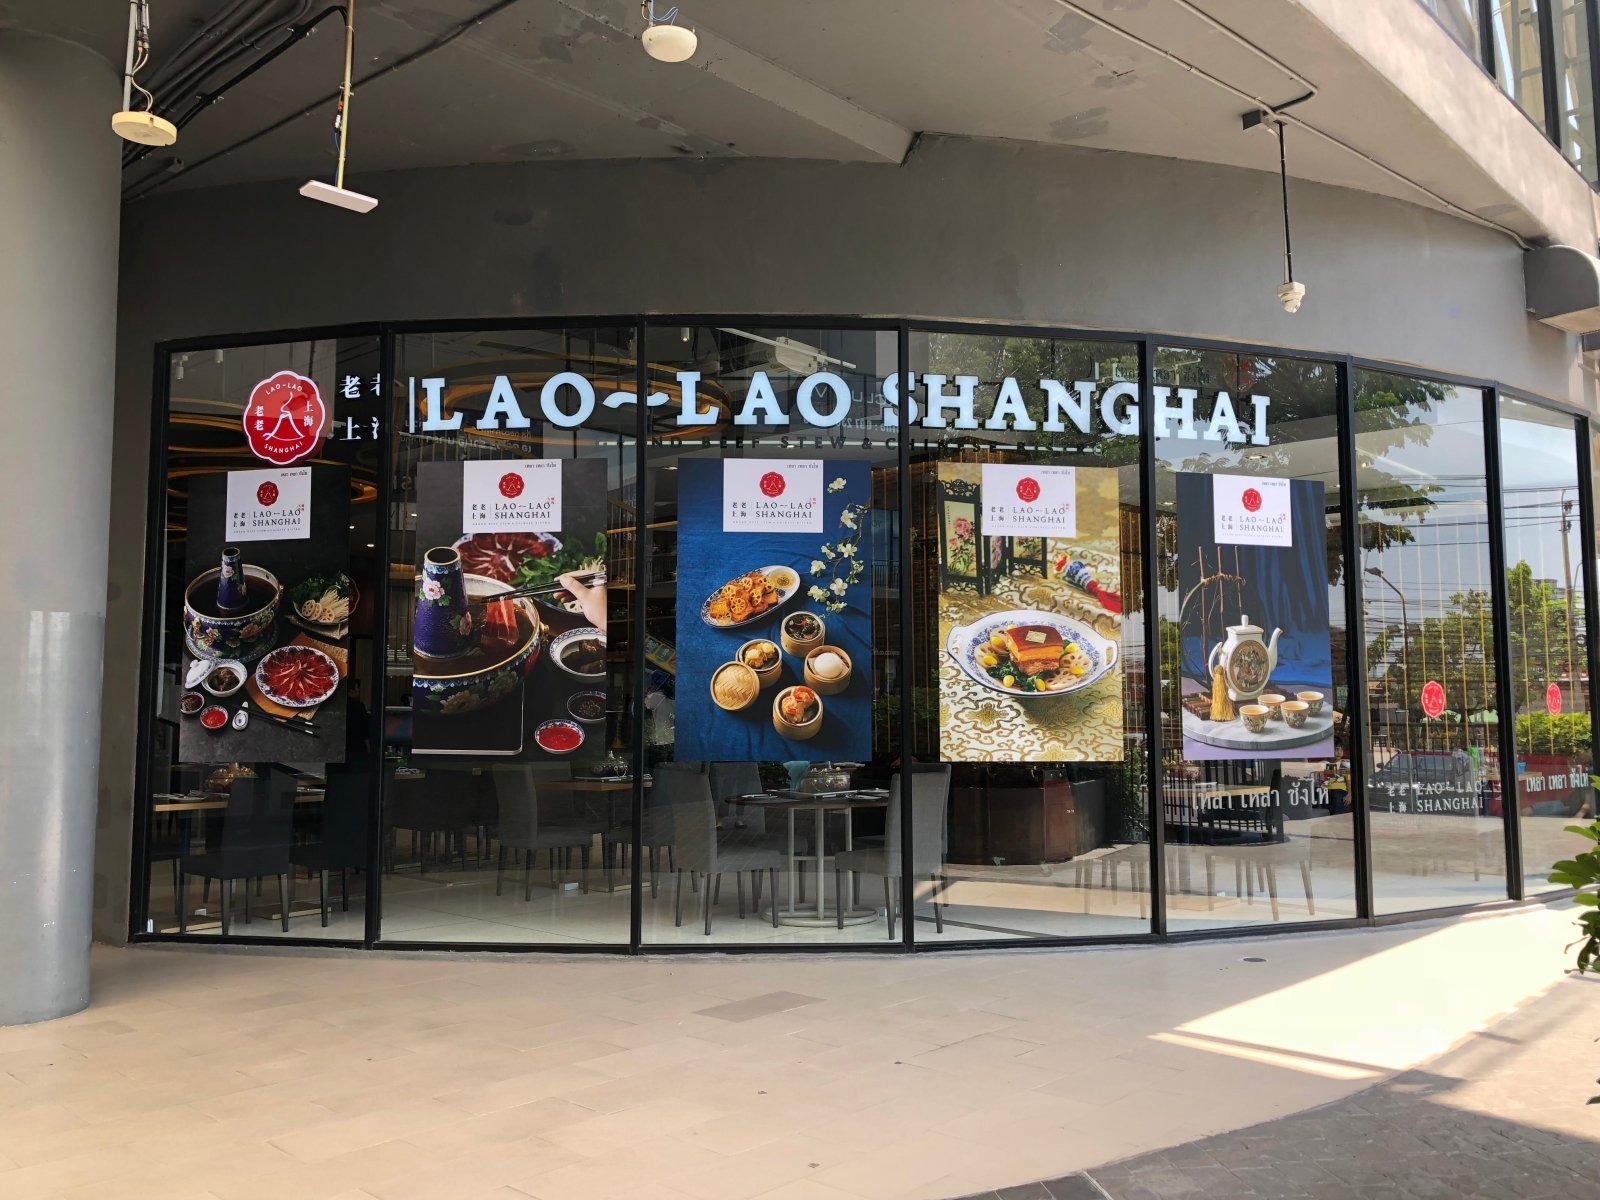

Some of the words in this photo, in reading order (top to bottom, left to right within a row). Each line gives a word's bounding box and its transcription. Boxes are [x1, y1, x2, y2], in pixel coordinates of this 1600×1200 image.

[265, 382, 303, 395] LAO-LAO
[882, 371, 1270, 446] SHANGHAI
[264, 441, 303, 454] SHANGHAI
[701, 436, 760, 449] BEEF
[781, 436, 847, 449] STEW
[494, 511, 550, 519] SHANGHAI
[755, 510, 812, 519] SHANGHAI
[1012, 515, 1065, 524] SHANGHAI
[252, 517, 301, 527] SHANGHAI
[1239, 523, 1283, 533] SHANGHAI
[1417, 796, 1484, 813] SHANGHAI
